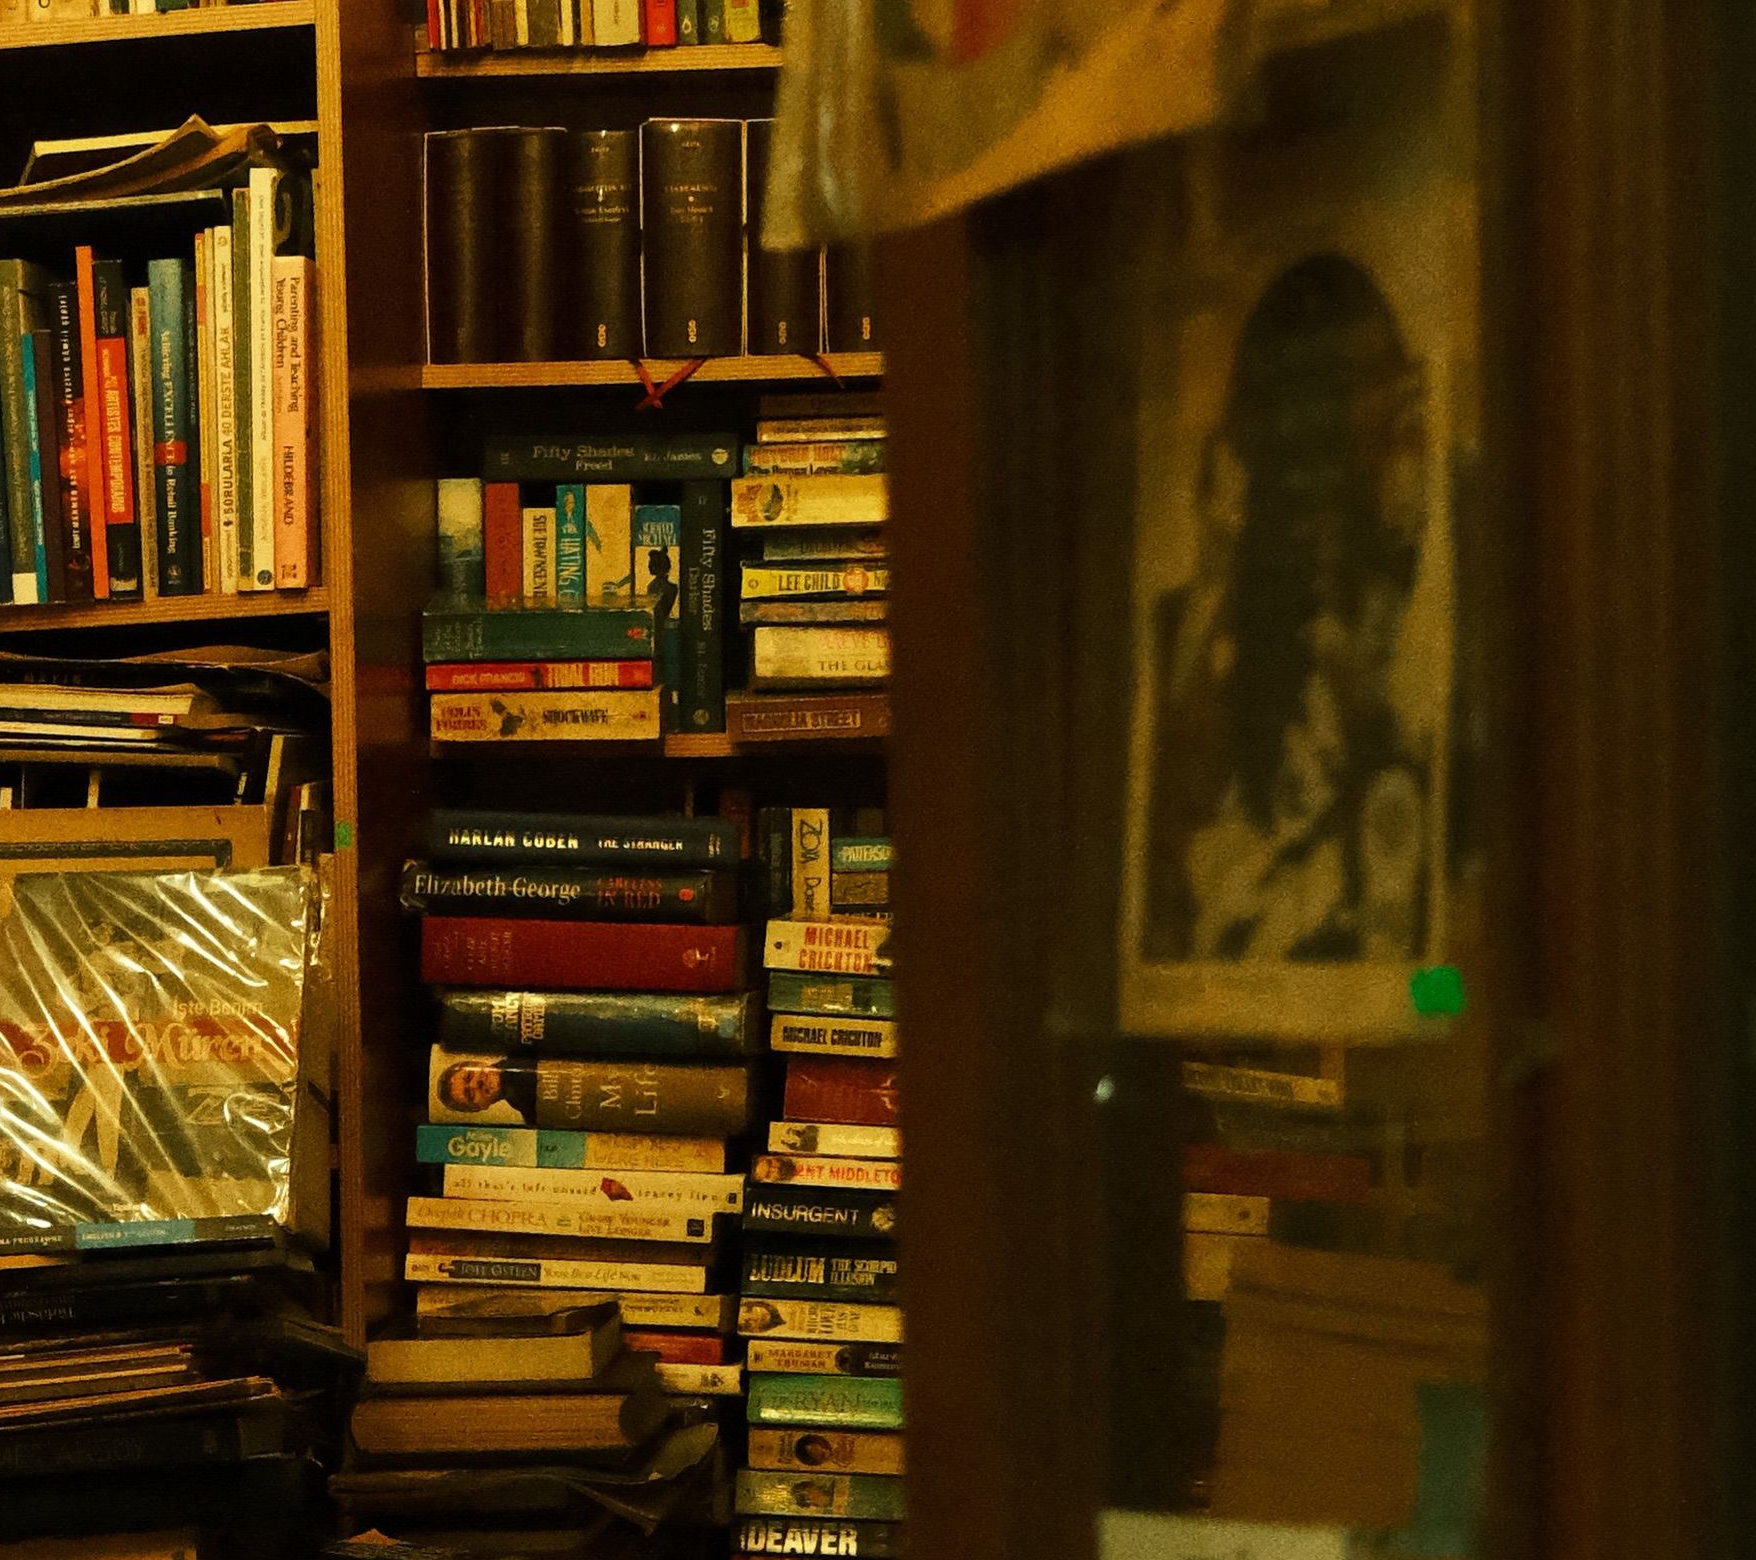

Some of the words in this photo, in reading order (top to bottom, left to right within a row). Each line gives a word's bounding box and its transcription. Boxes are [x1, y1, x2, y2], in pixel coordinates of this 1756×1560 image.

[274, 278, 287, 315] Young
[288, 277, 302, 331] Parenting
[275, 318, 290, 369] Children
[291, 337, 301, 358] and
[287, 363, 302, 413] Teaching
[533, 445, 571, 461] Fifty
[576, 445, 635, 457] Shades
[282, 445, 295, 526] HILDEBRAND
[167, 511, 177, 554] Banking
[700, 528, 716, 568] Fifty
[804, 573, 840, 590] CHILD
[703, 573, 715, 631] Shades
[449, 827, 515, 847] HARLAN
[522, 829, 579, 850] COBEN
[414, 874, 506, 896] Elizabeth
[512, 876, 581, 905] George
[803, 927, 869, 950] MICHAEL
[799, 949, 873, 972] CRICHTON
[782, 1026, 827, 1045] MICHAEL
[831, 1028, 883, 1048] CRICHTON
[448, 1137, 510, 1162] Gayle
[468, 1207, 547, 1225] CHOPRA
[751, 1202, 859, 1224] INSURGENT
